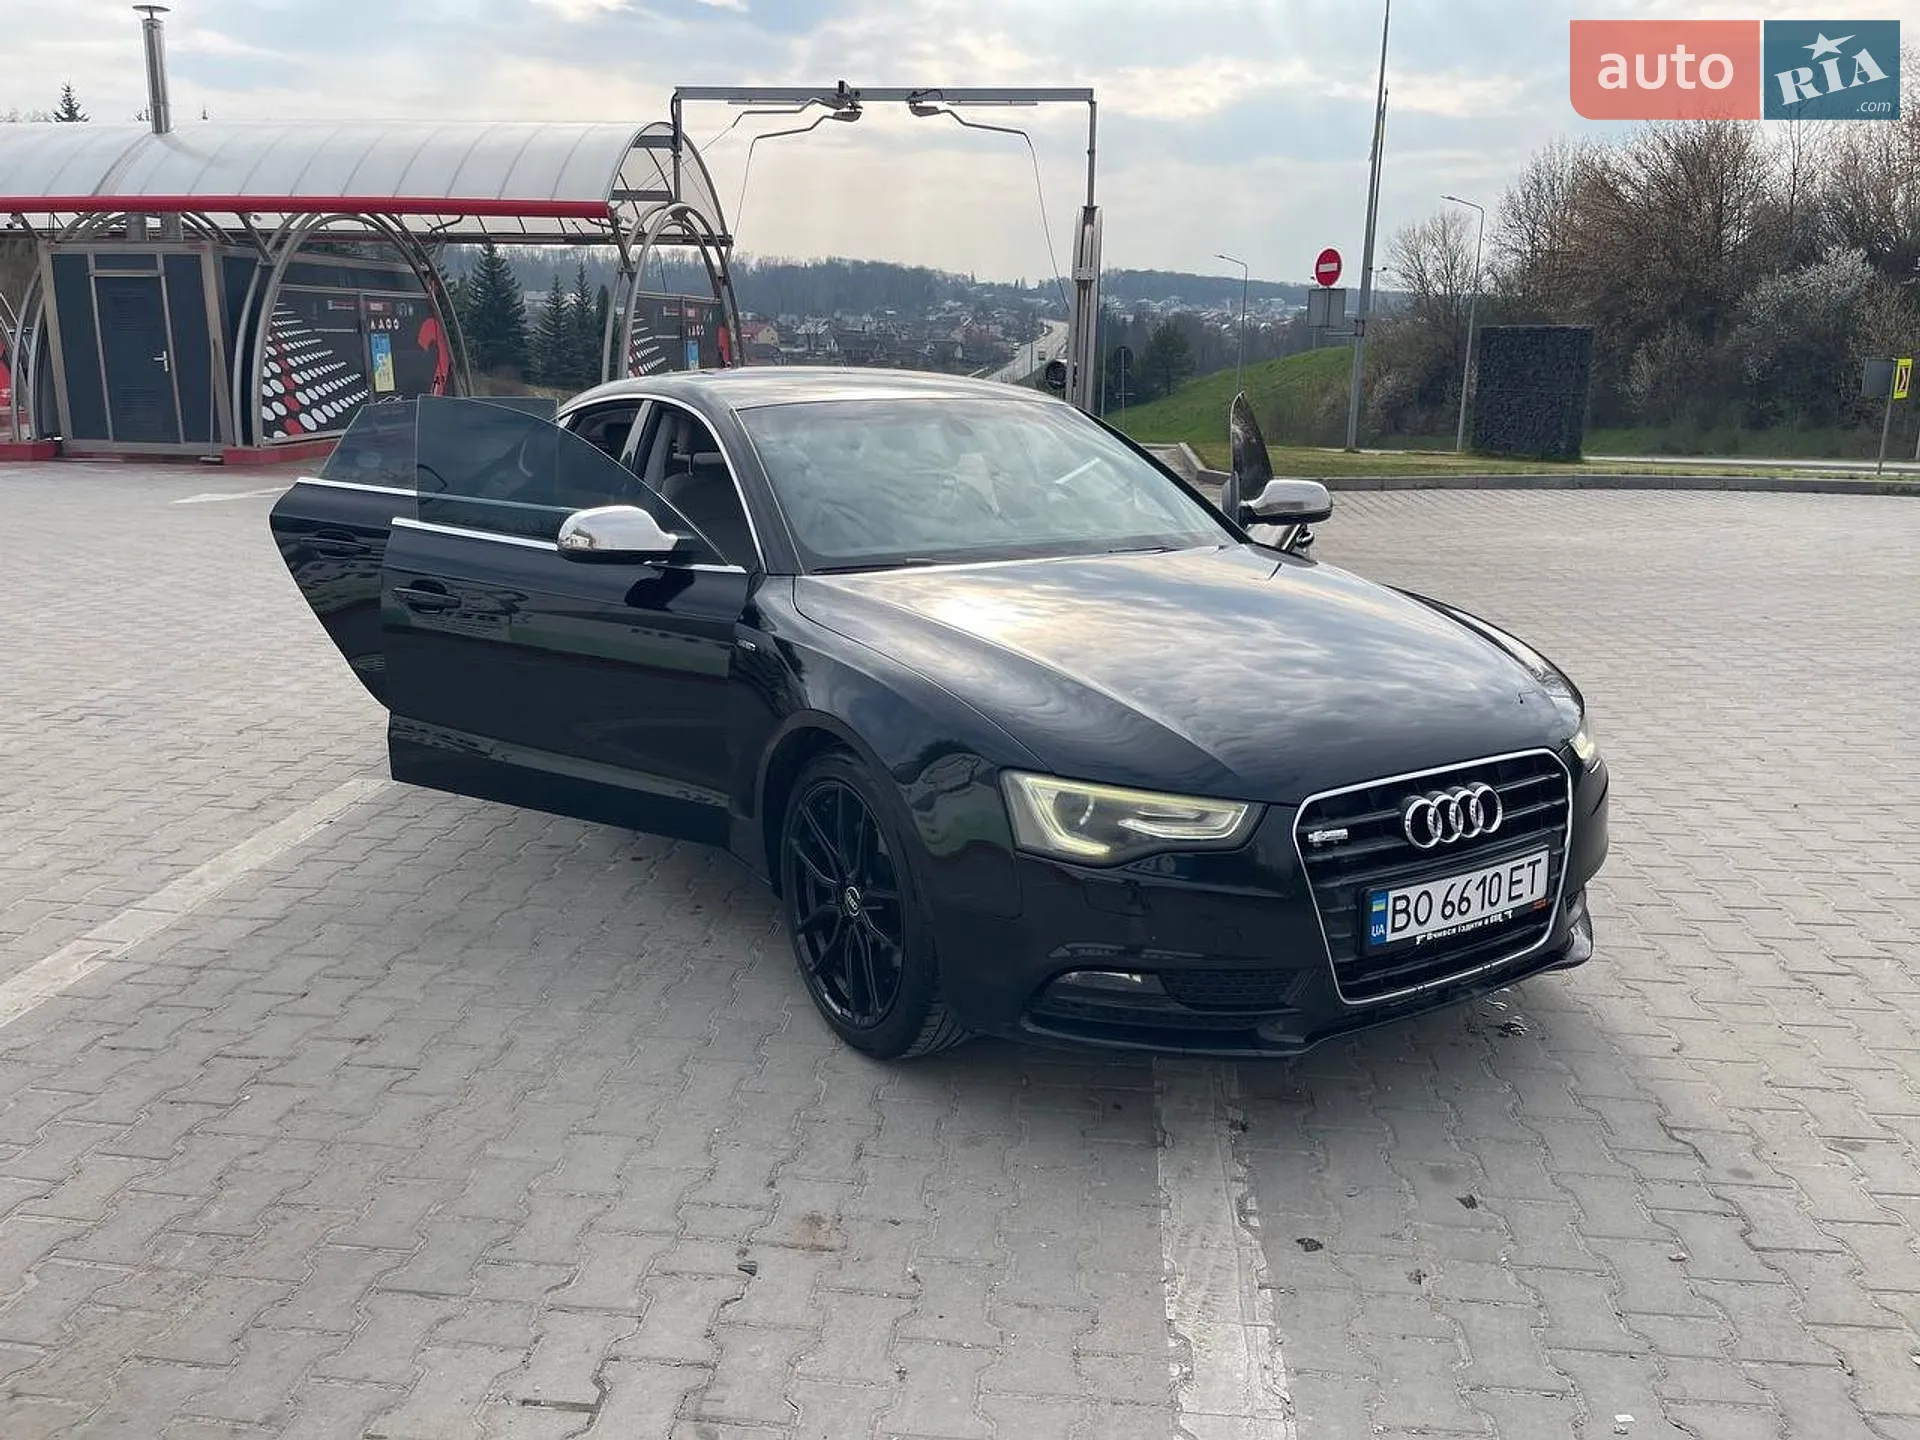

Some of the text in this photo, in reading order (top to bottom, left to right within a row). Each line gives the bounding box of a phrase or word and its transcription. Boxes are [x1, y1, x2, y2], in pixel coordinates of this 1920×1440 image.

[1391, 858, 1542, 933] BO 6610 ET
[1371, 924, 1385, 937] UA
